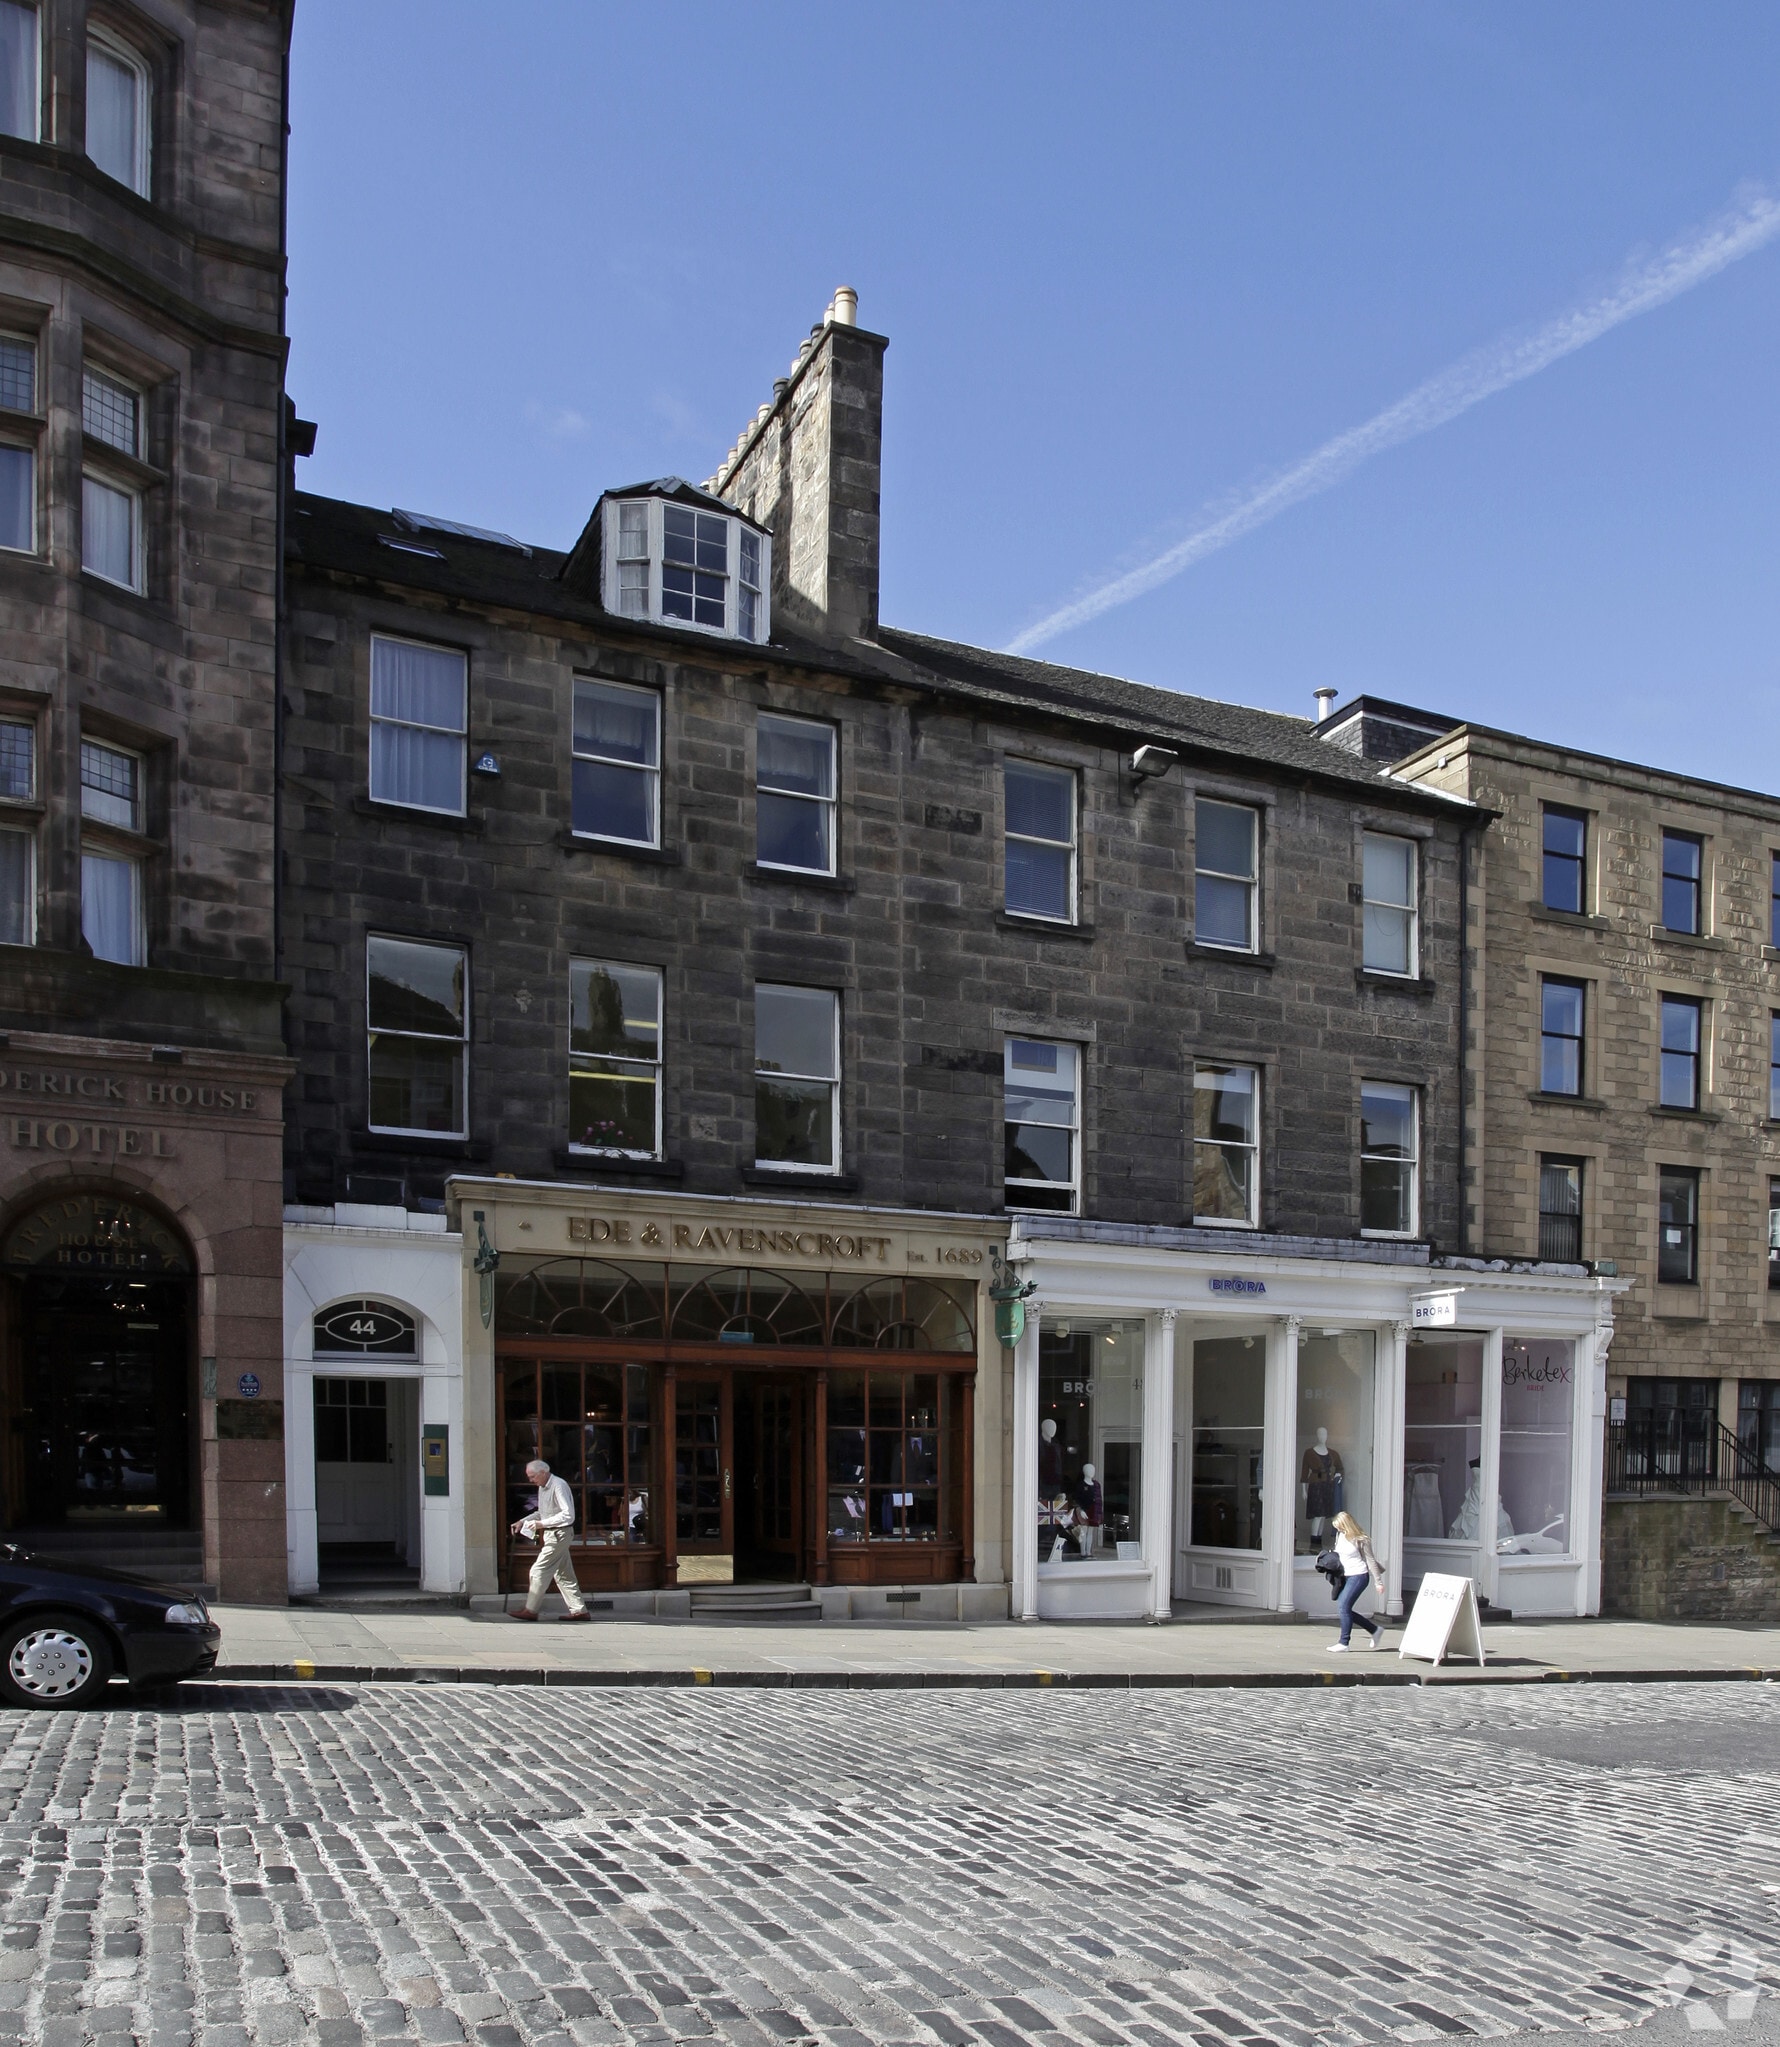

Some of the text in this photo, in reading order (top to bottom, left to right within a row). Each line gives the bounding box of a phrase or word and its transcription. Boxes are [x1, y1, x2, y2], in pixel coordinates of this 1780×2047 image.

[147, 1082, 258, 1111] HOUSE
[9, 1118, 177, 1158] HOTEL
[12, 1198, 179, 1268] FREDERICK
[57, 1231, 139, 1249] HOUSE
[567, 1216, 632, 1243] EDE
[640, 1222, 664, 1244] &
[673, 1223, 891, 1260] RAVENSCROFT
[936, 1246, 982, 1265] 1689
[57, 1250, 140, 1266] HOTEL
[1211, 1278, 1266, 1294] BRORA
[1415, 1304, 1450, 1318] BRORA
[349, 1319, 376, 1335] 44
[1501, 1354, 1572, 1386] Berketex
[1526, 1384, 1545, 1392] BRIDE
[1423, 1588, 1455, 1601] BRORA
